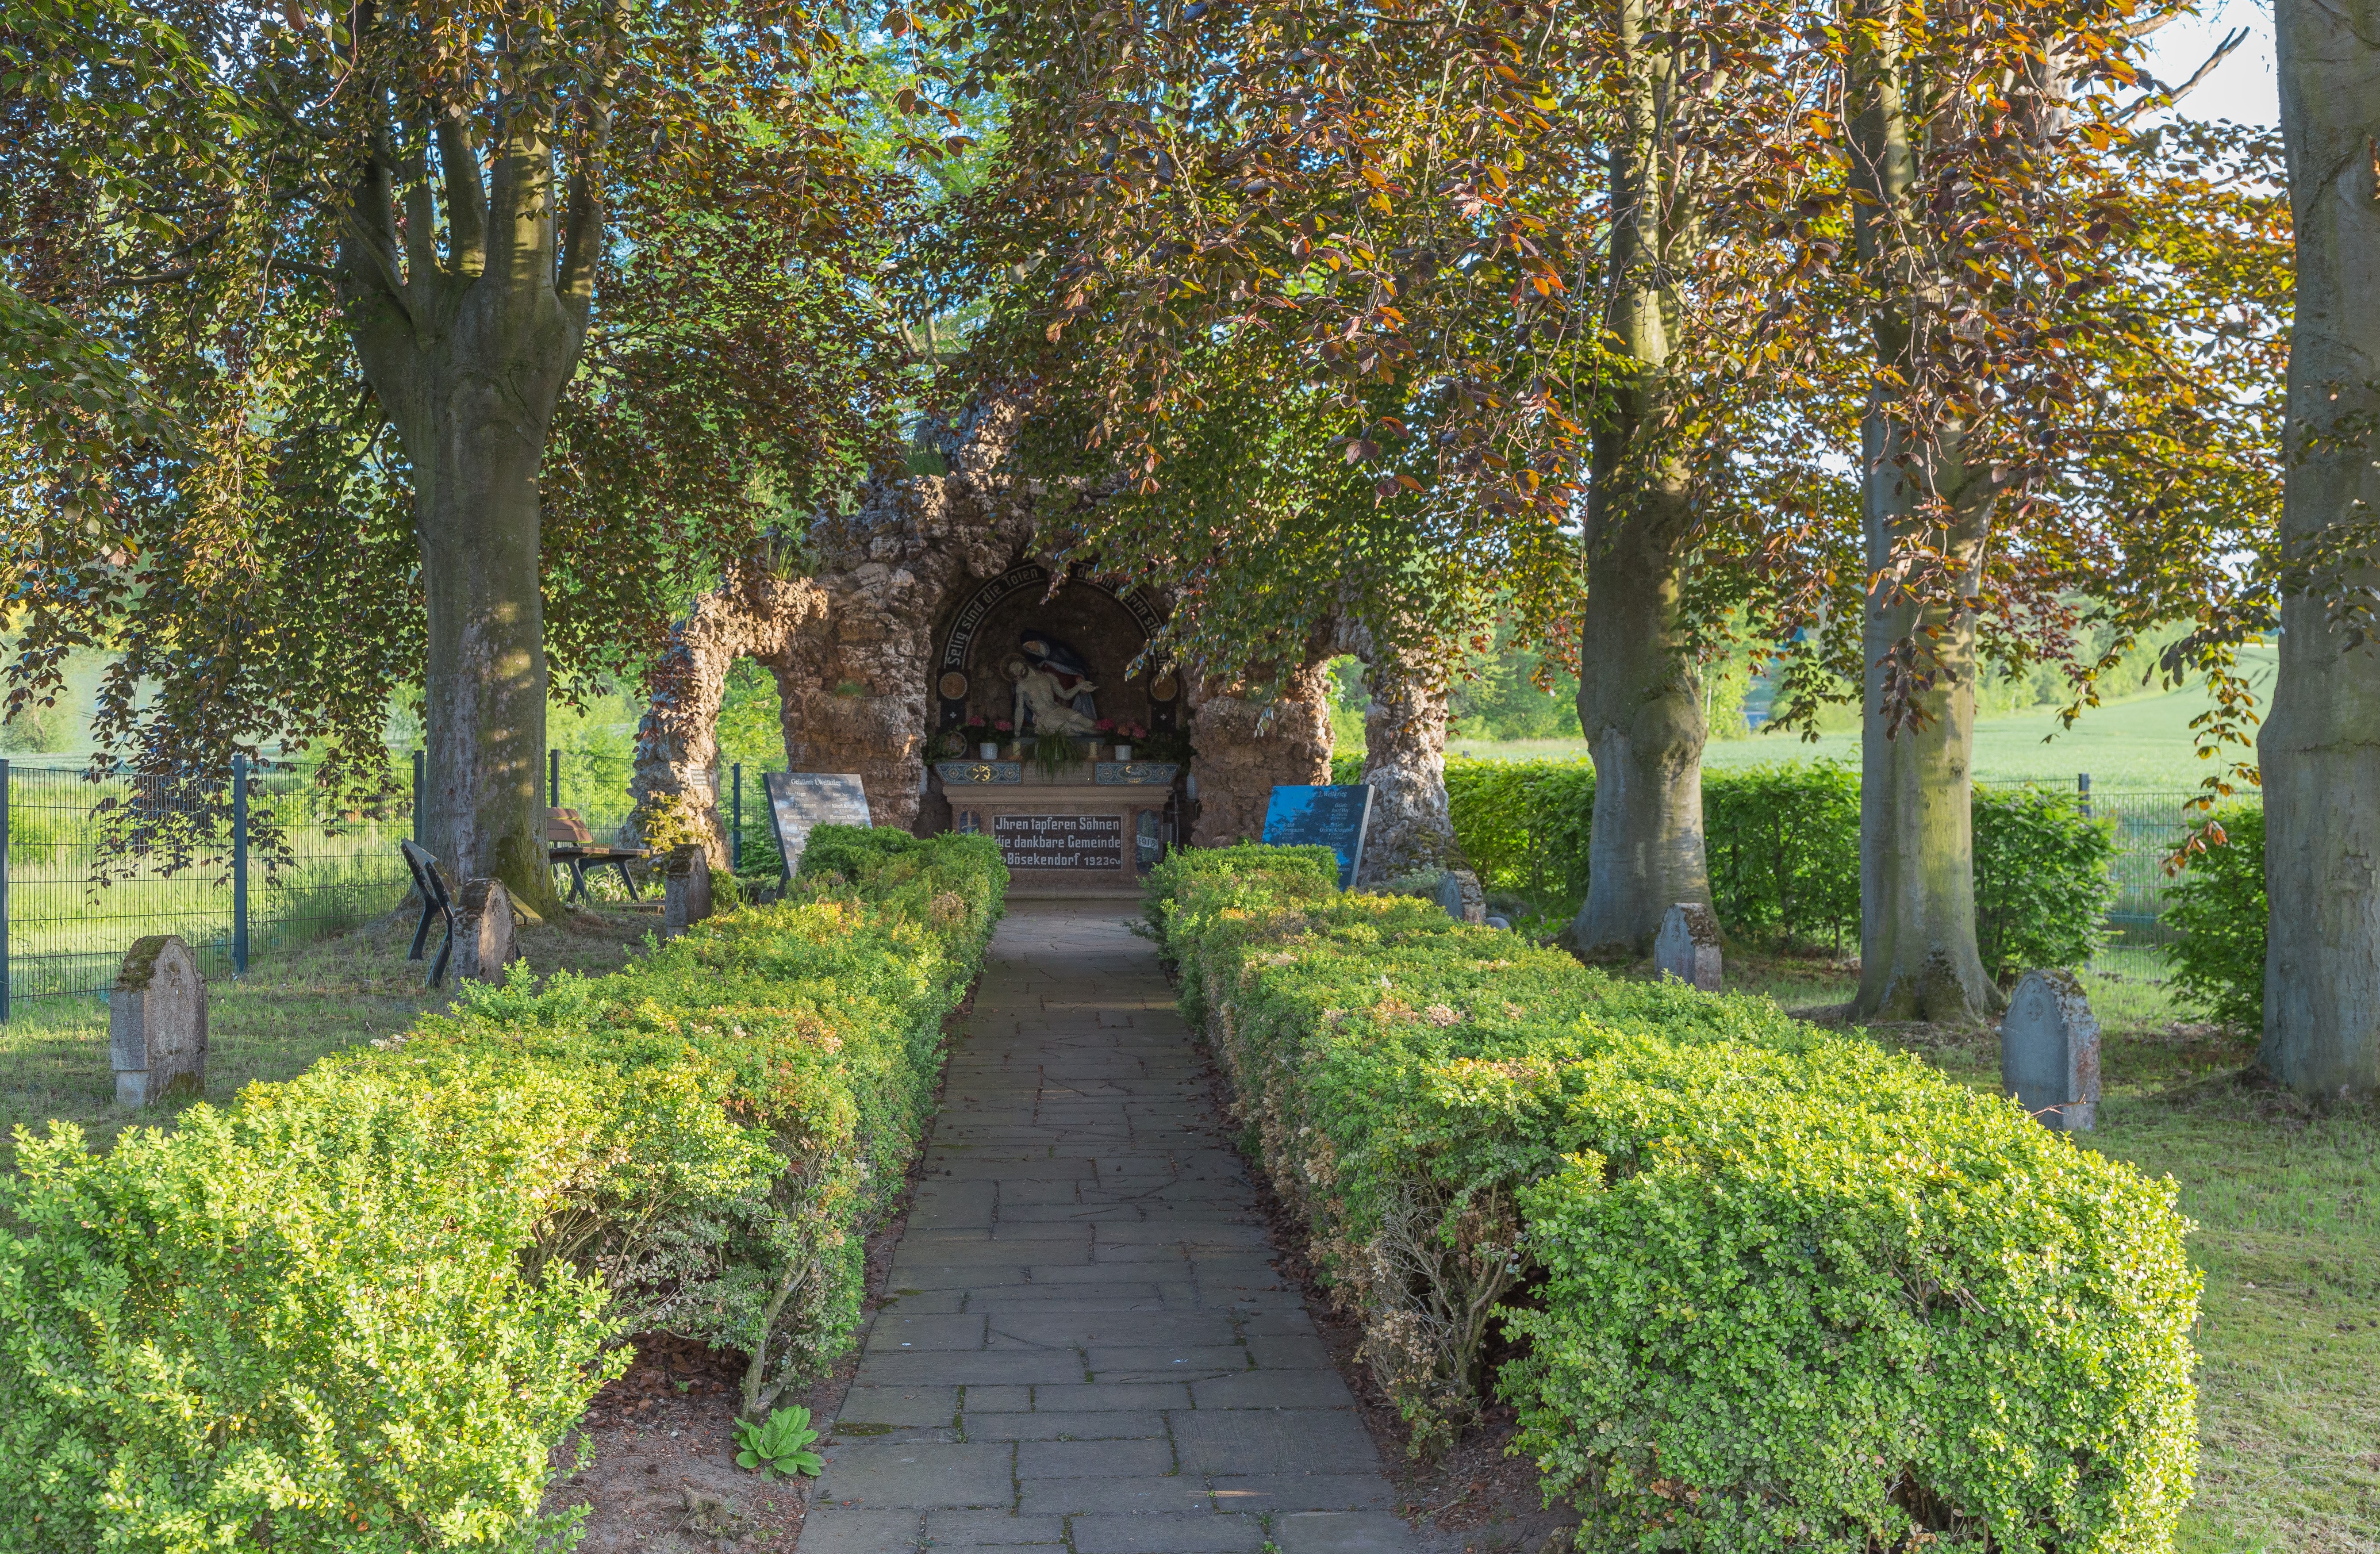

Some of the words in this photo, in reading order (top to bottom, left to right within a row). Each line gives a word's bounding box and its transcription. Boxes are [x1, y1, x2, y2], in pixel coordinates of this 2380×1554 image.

[947, 632, 969, 666] Selig
[962, 600, 985, 629] sind
[983, 585, 1003, 603] die
[1002, 568, 1038, 587] Toten
[1031, 817, 1076, 834] tapferen
[1079, 817, 1119, 830] Söhnen
[994, 835, 1011, 848] die
[1014, 835, 1064, 848] dankbare
[1067, 835, 1121, 848] Gemeinde
[1138, 837, 1156, 848] 1918
[1007, 852, 1080, 865] Bösekendorf
[1084, 856, 1109, 866] 1923
